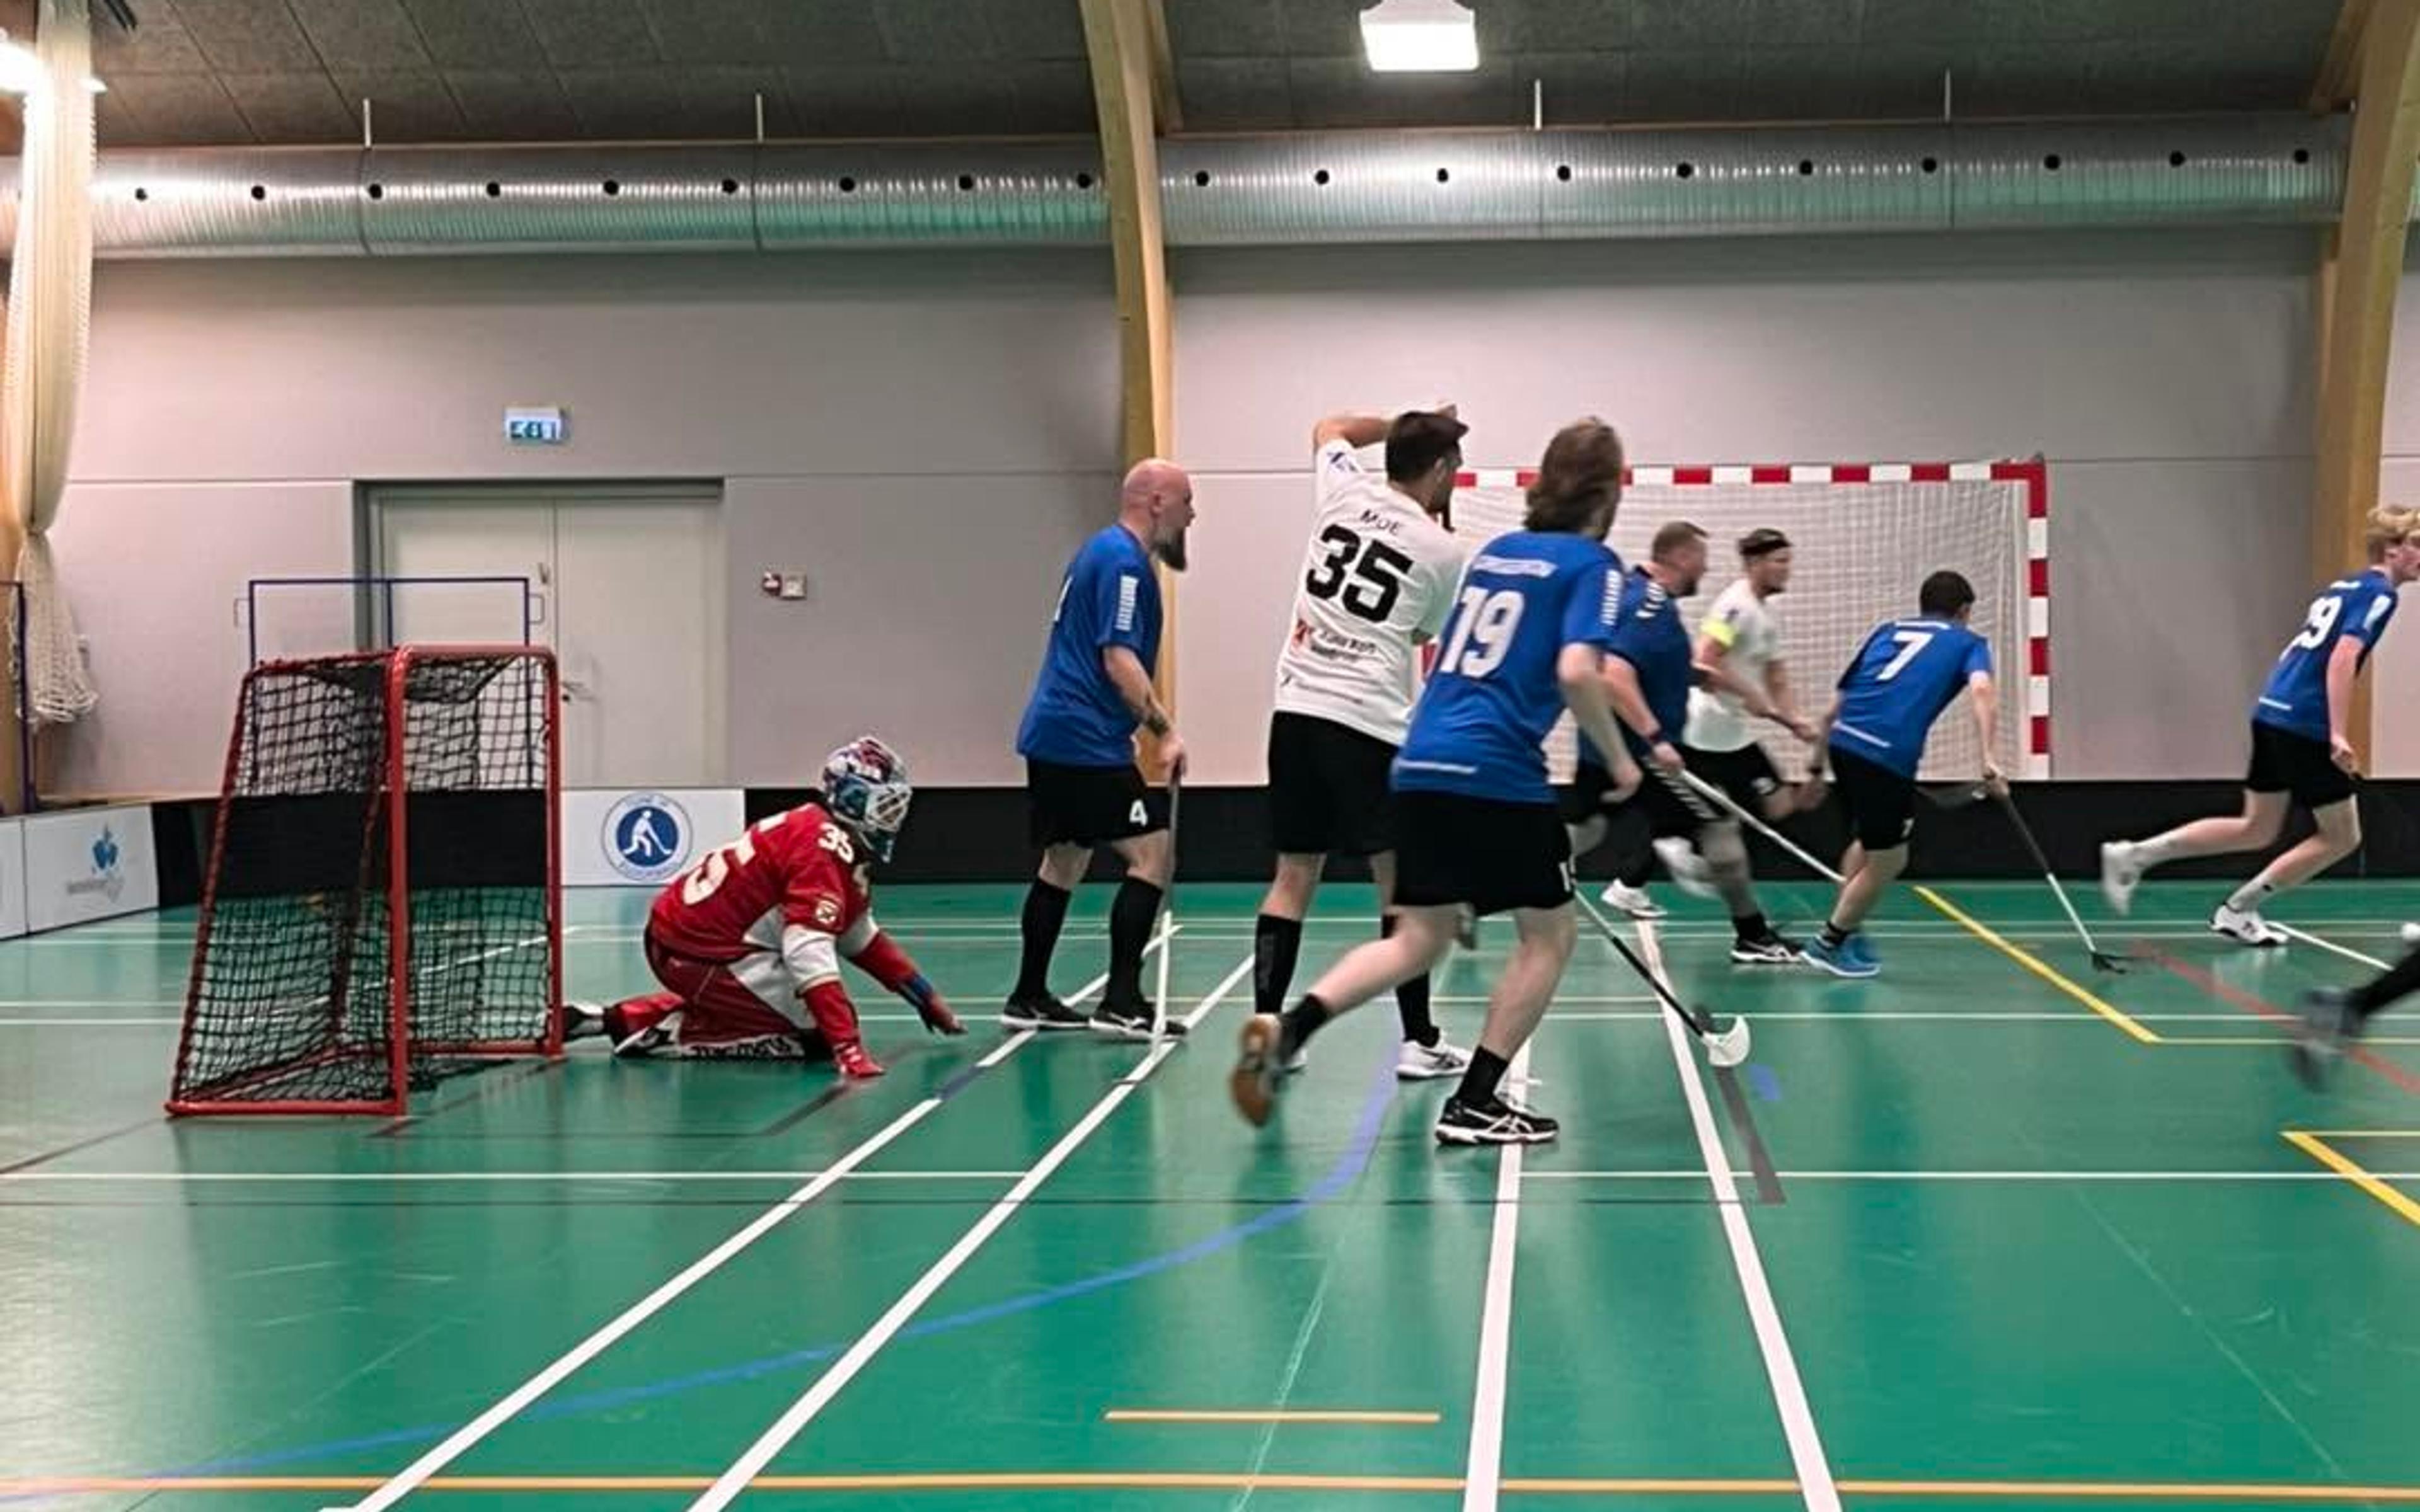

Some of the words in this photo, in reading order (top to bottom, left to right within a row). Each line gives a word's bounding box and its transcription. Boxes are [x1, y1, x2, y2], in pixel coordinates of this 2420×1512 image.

[1306, 524, 1414, 623] 35
[1439, 585, 1524, 678] 19
[1877, 631, 1933, 680] 7
[1129, 799, 1148, 827] 4
[818, 822, 854, 864] 35
